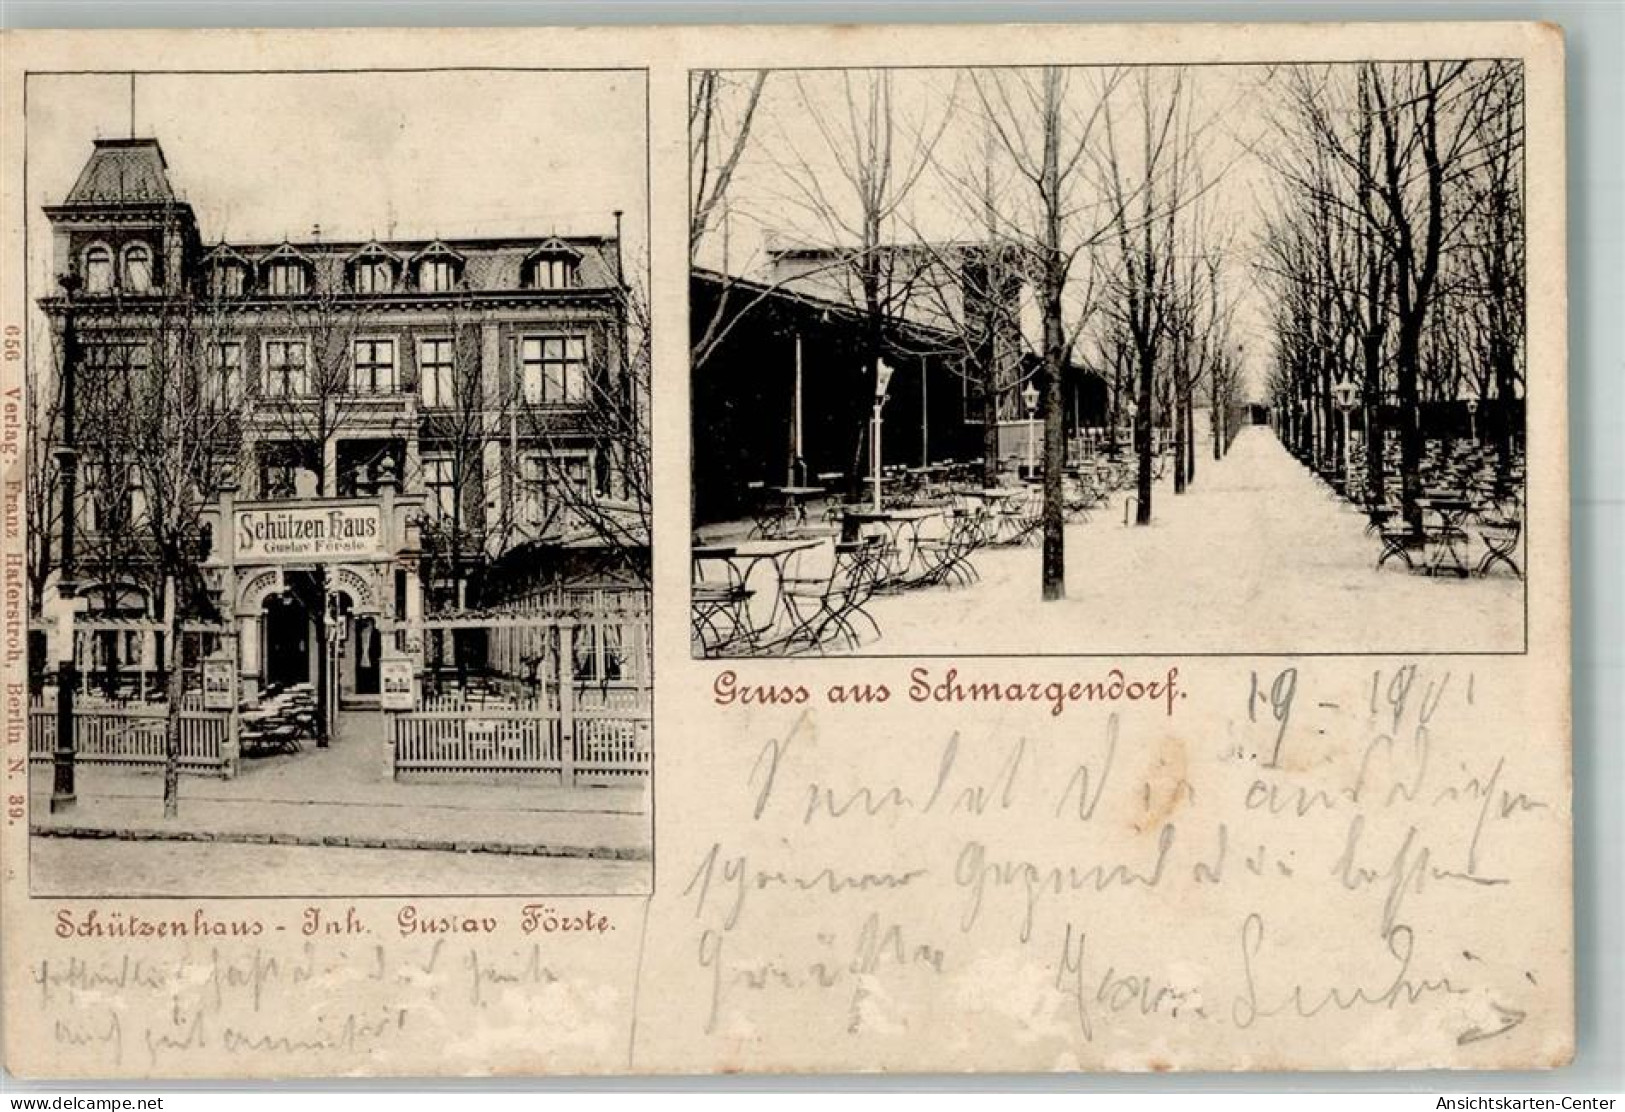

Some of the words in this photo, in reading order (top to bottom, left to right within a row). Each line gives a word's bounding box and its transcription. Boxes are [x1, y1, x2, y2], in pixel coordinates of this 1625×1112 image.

[4, 325, 21, 361] 656
[4, 387, 21, 464] Verlag:
[5, 481, 22, 539] Franz
[5, 552, 23, 668] Haferstroh,
[7, 682, 24, 745] Berlin
[714, 670, 809, 704] Gruss
[828, 685, 890, 704] aus
[909, 668, 1187, 716] Schmargendorf.
[8, 757, 25, 780] N.
[55, 908, 264, 938] Schützenhaus
[301, 907, 371, 935] Inh.
[398, 905, 496, 936] Gustav
[522, 904, 616, 936] Förste.
